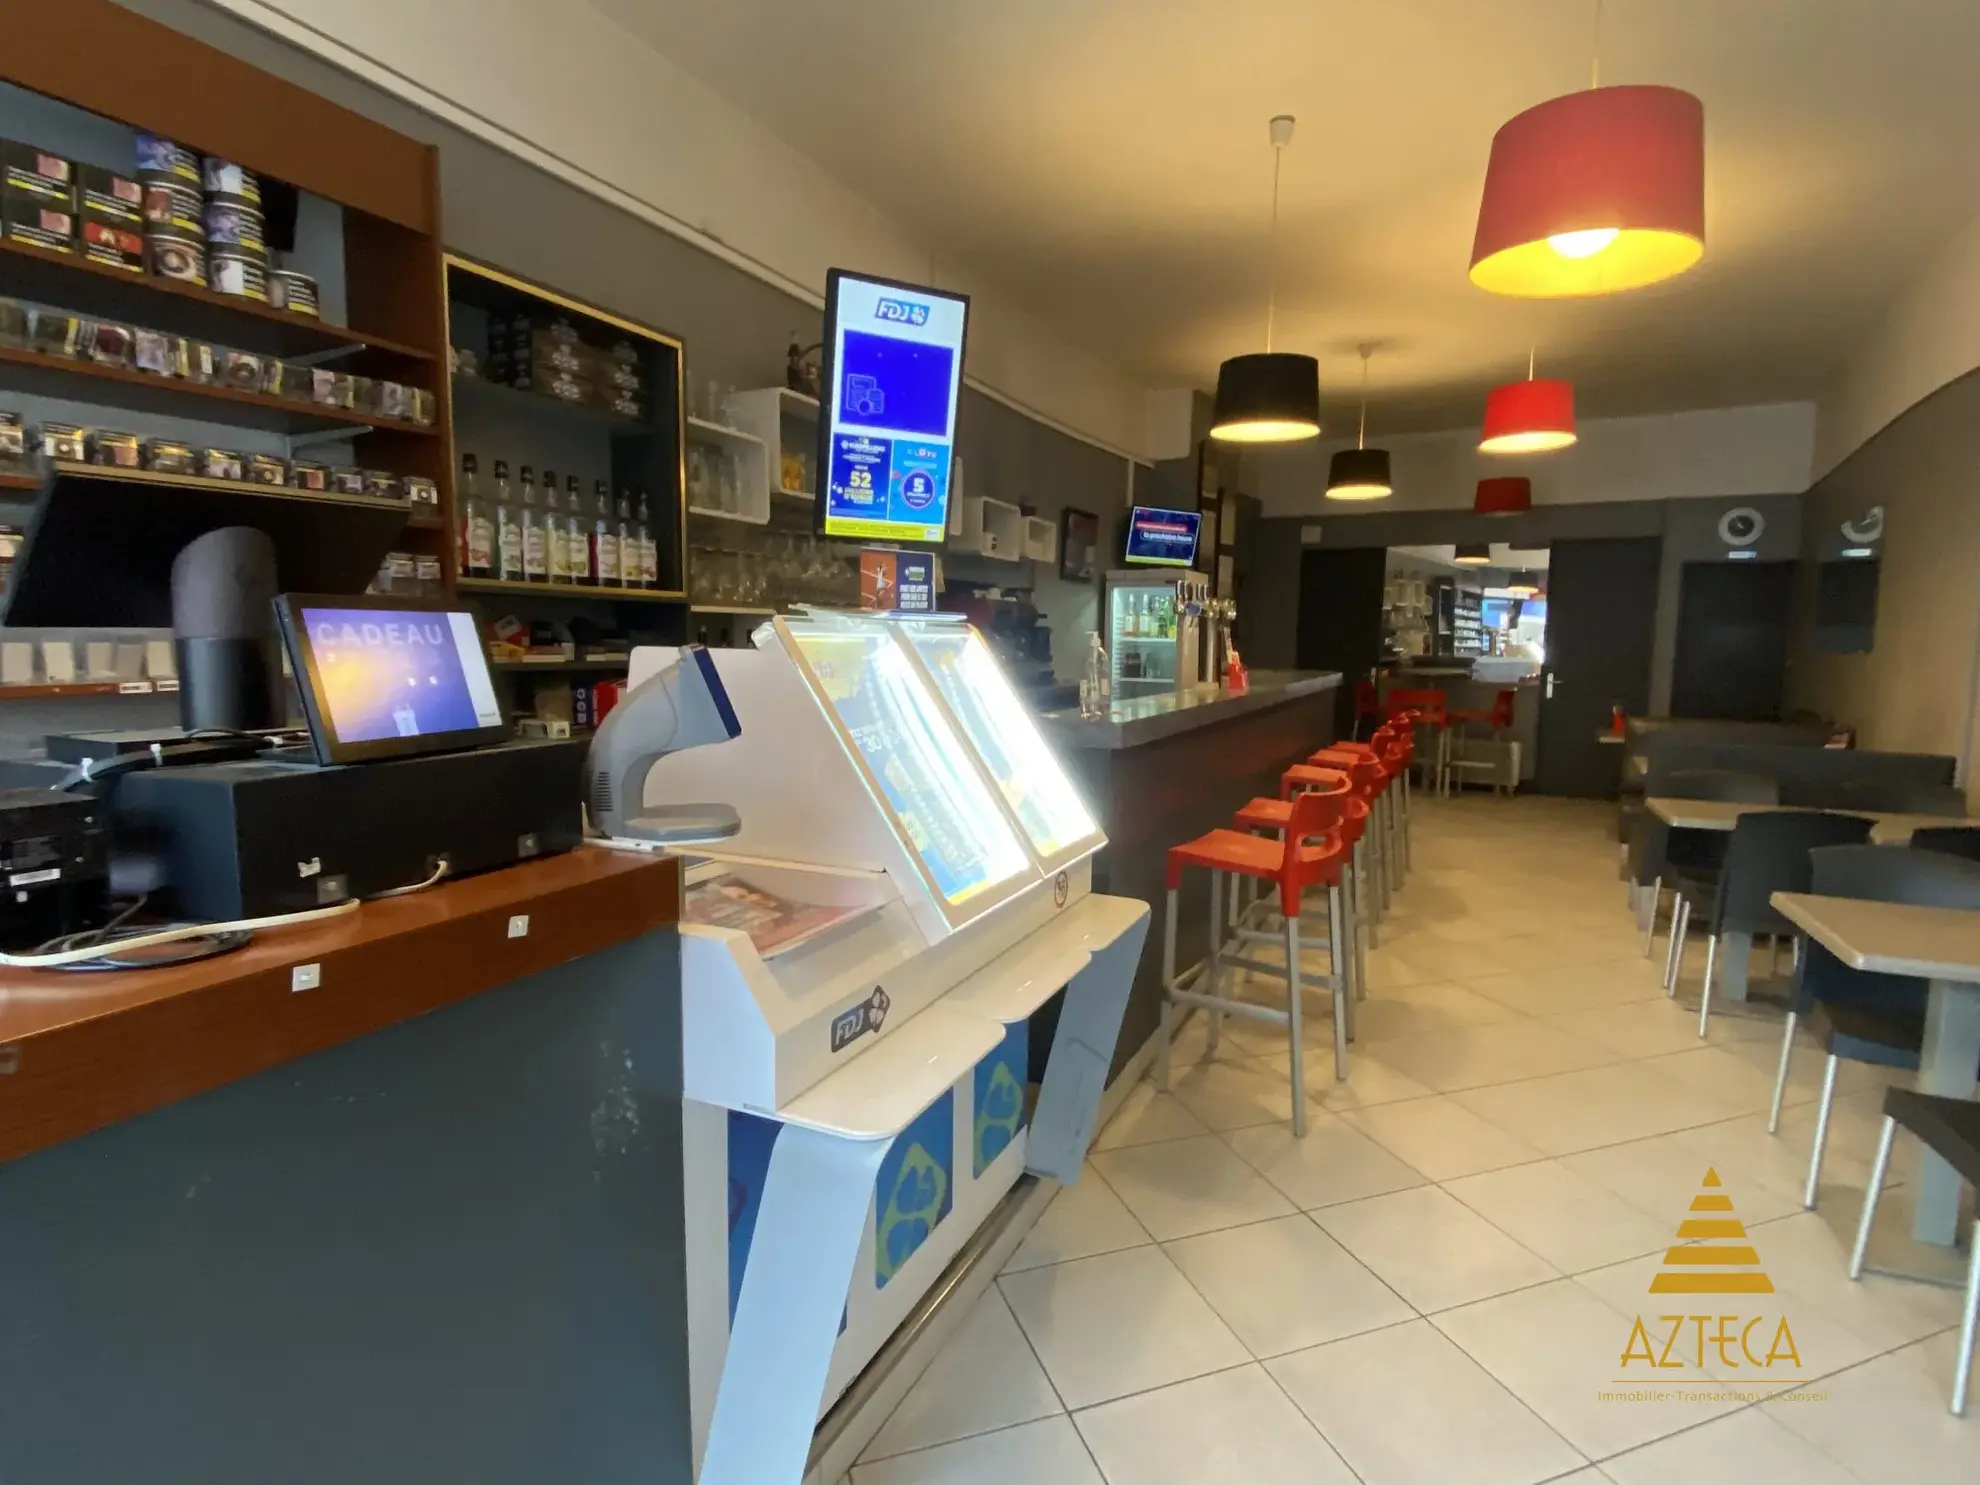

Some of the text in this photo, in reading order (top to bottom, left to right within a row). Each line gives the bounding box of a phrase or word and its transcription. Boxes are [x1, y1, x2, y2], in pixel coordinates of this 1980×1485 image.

[877, 300, 910, 321] FDJ
[850, 470, 872, 488] 52
[316, 621, 445, 647] CADEAU
[835, 1007, 865, 1045] FDJ
